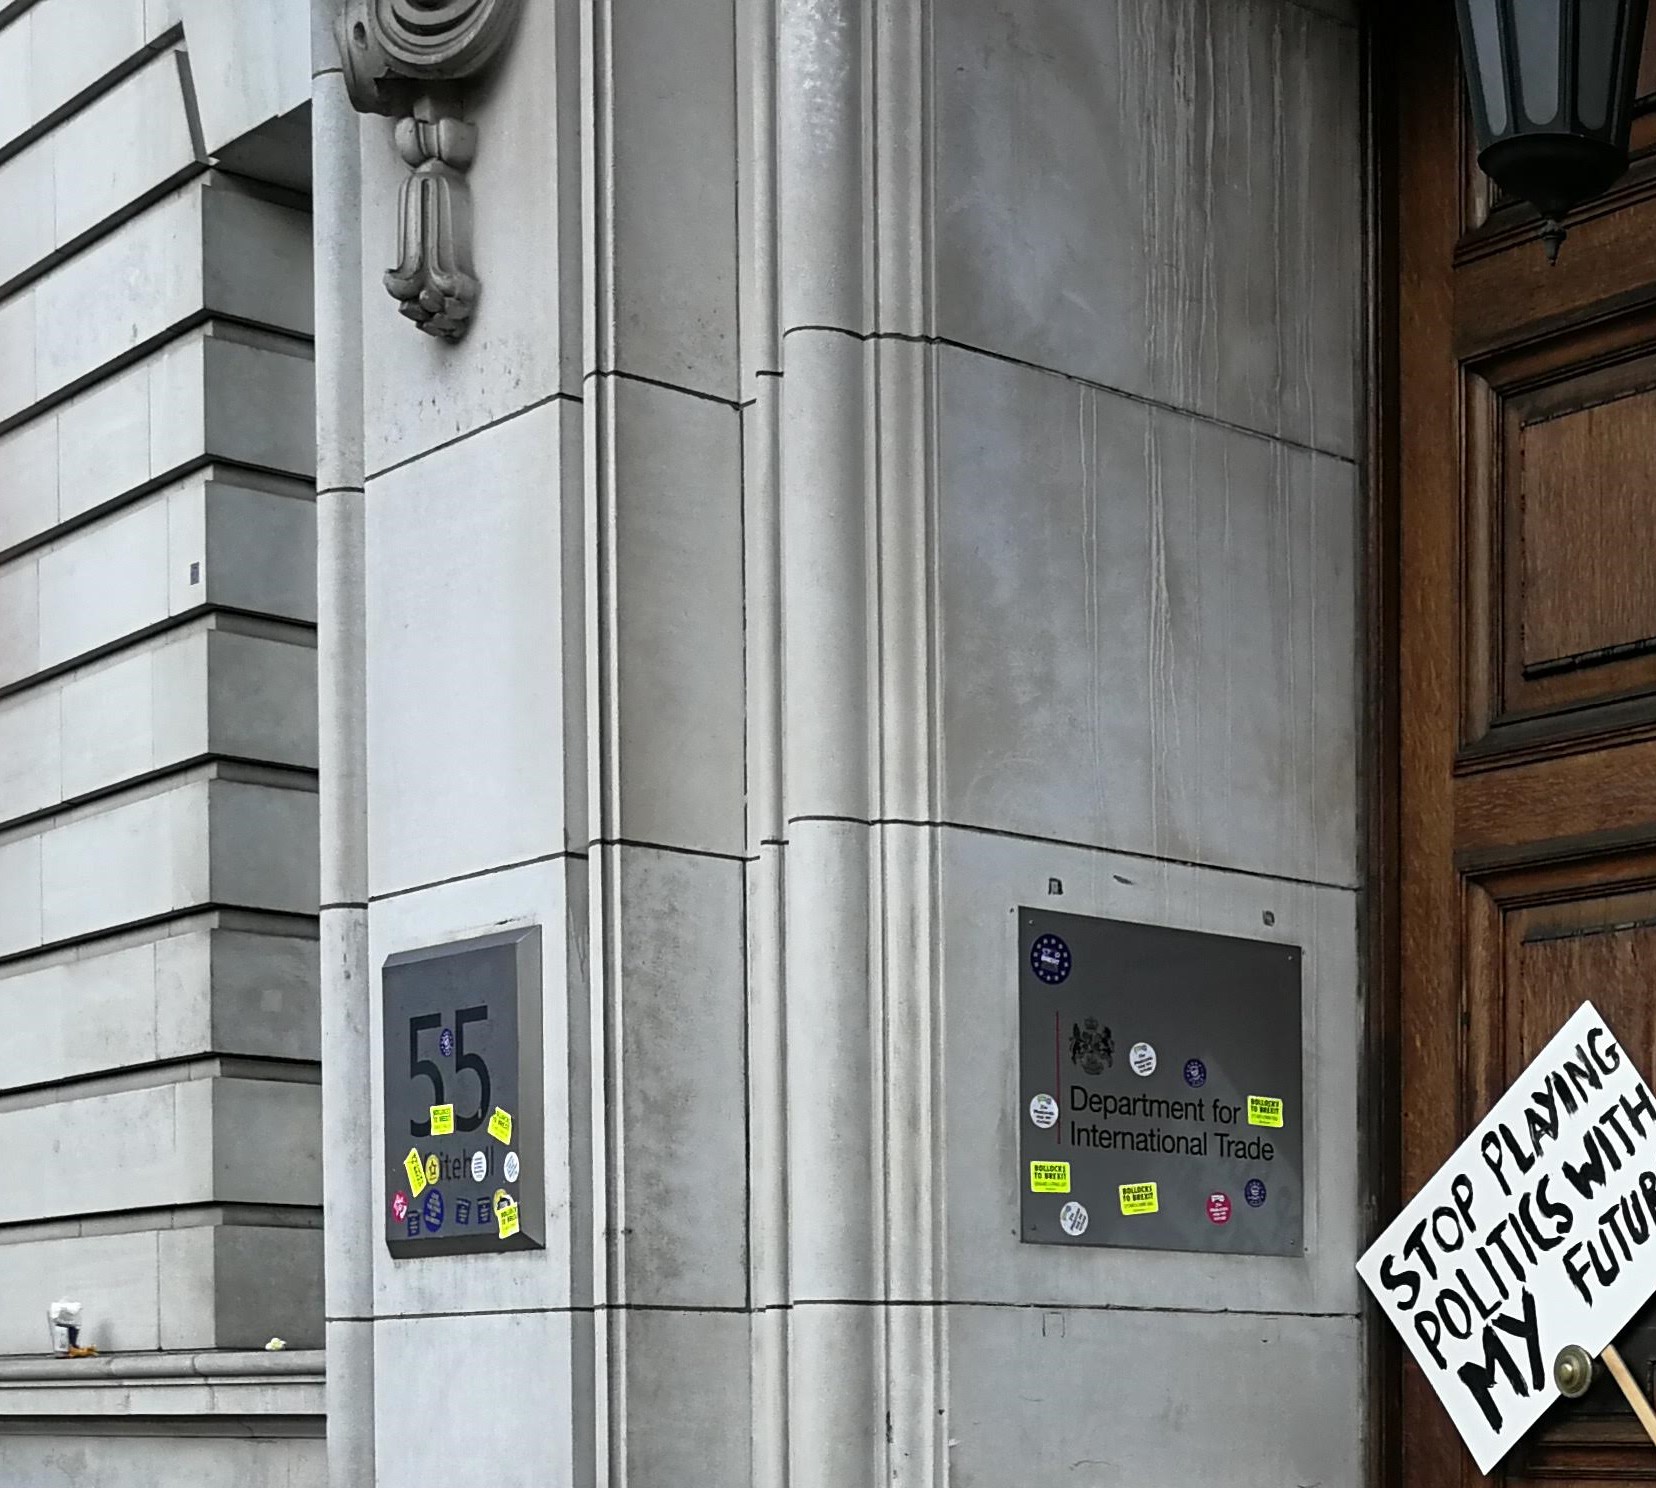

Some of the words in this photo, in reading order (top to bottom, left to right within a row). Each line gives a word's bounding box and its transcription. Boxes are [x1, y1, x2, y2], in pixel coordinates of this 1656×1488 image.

[410, 1005, 491, 1138] 55
[1070, 1086, 1204, 1124] Department
[1212, 1098, 1241, 1125] for
[1070, 1121, 1207, 1157] International
[1214, 1132, 1274, 1162] Trade
[1380, 1174, 1476, 1311] STOP
[1481, 1028, 1622, 1195] PLAYING
[1414, 1174, 1573, 1370] POLITICS
[1457, 1286, 1545, 1434] MY
